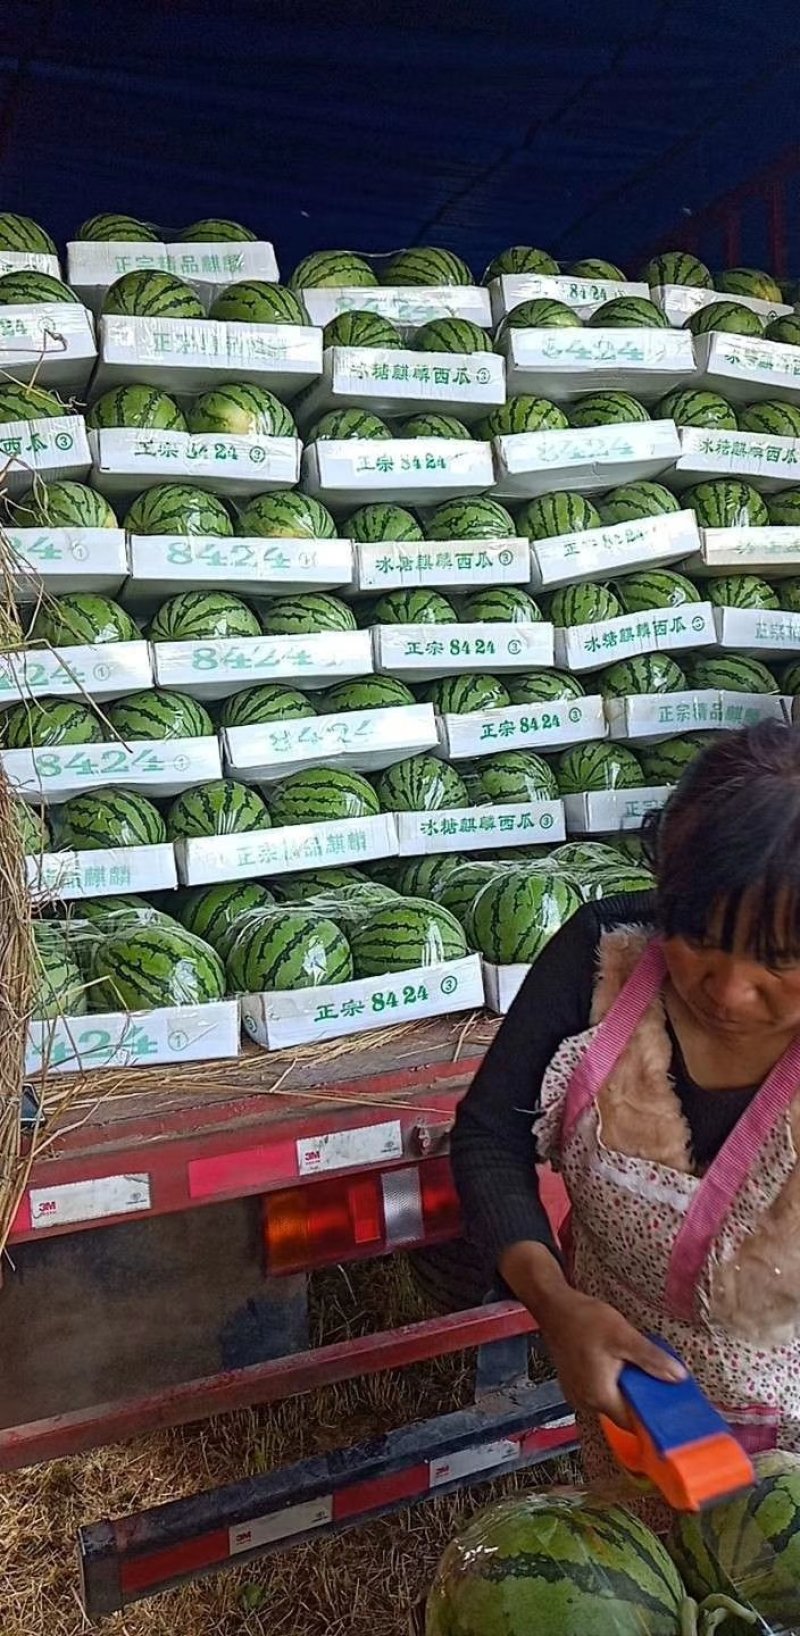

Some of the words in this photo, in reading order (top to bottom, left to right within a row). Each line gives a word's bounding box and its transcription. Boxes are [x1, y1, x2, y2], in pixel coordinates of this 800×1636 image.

[55, 432, 73, 451] ③
[166, 541, 291, 569] 8424
[35, 748, 165, 777] 8424
[539, 813, 554, 829] ③
[440, 975, 458, 995] ③
[304, 1150, 321, 1161] 3M
[38, 1201, 57, 1212] 3M
